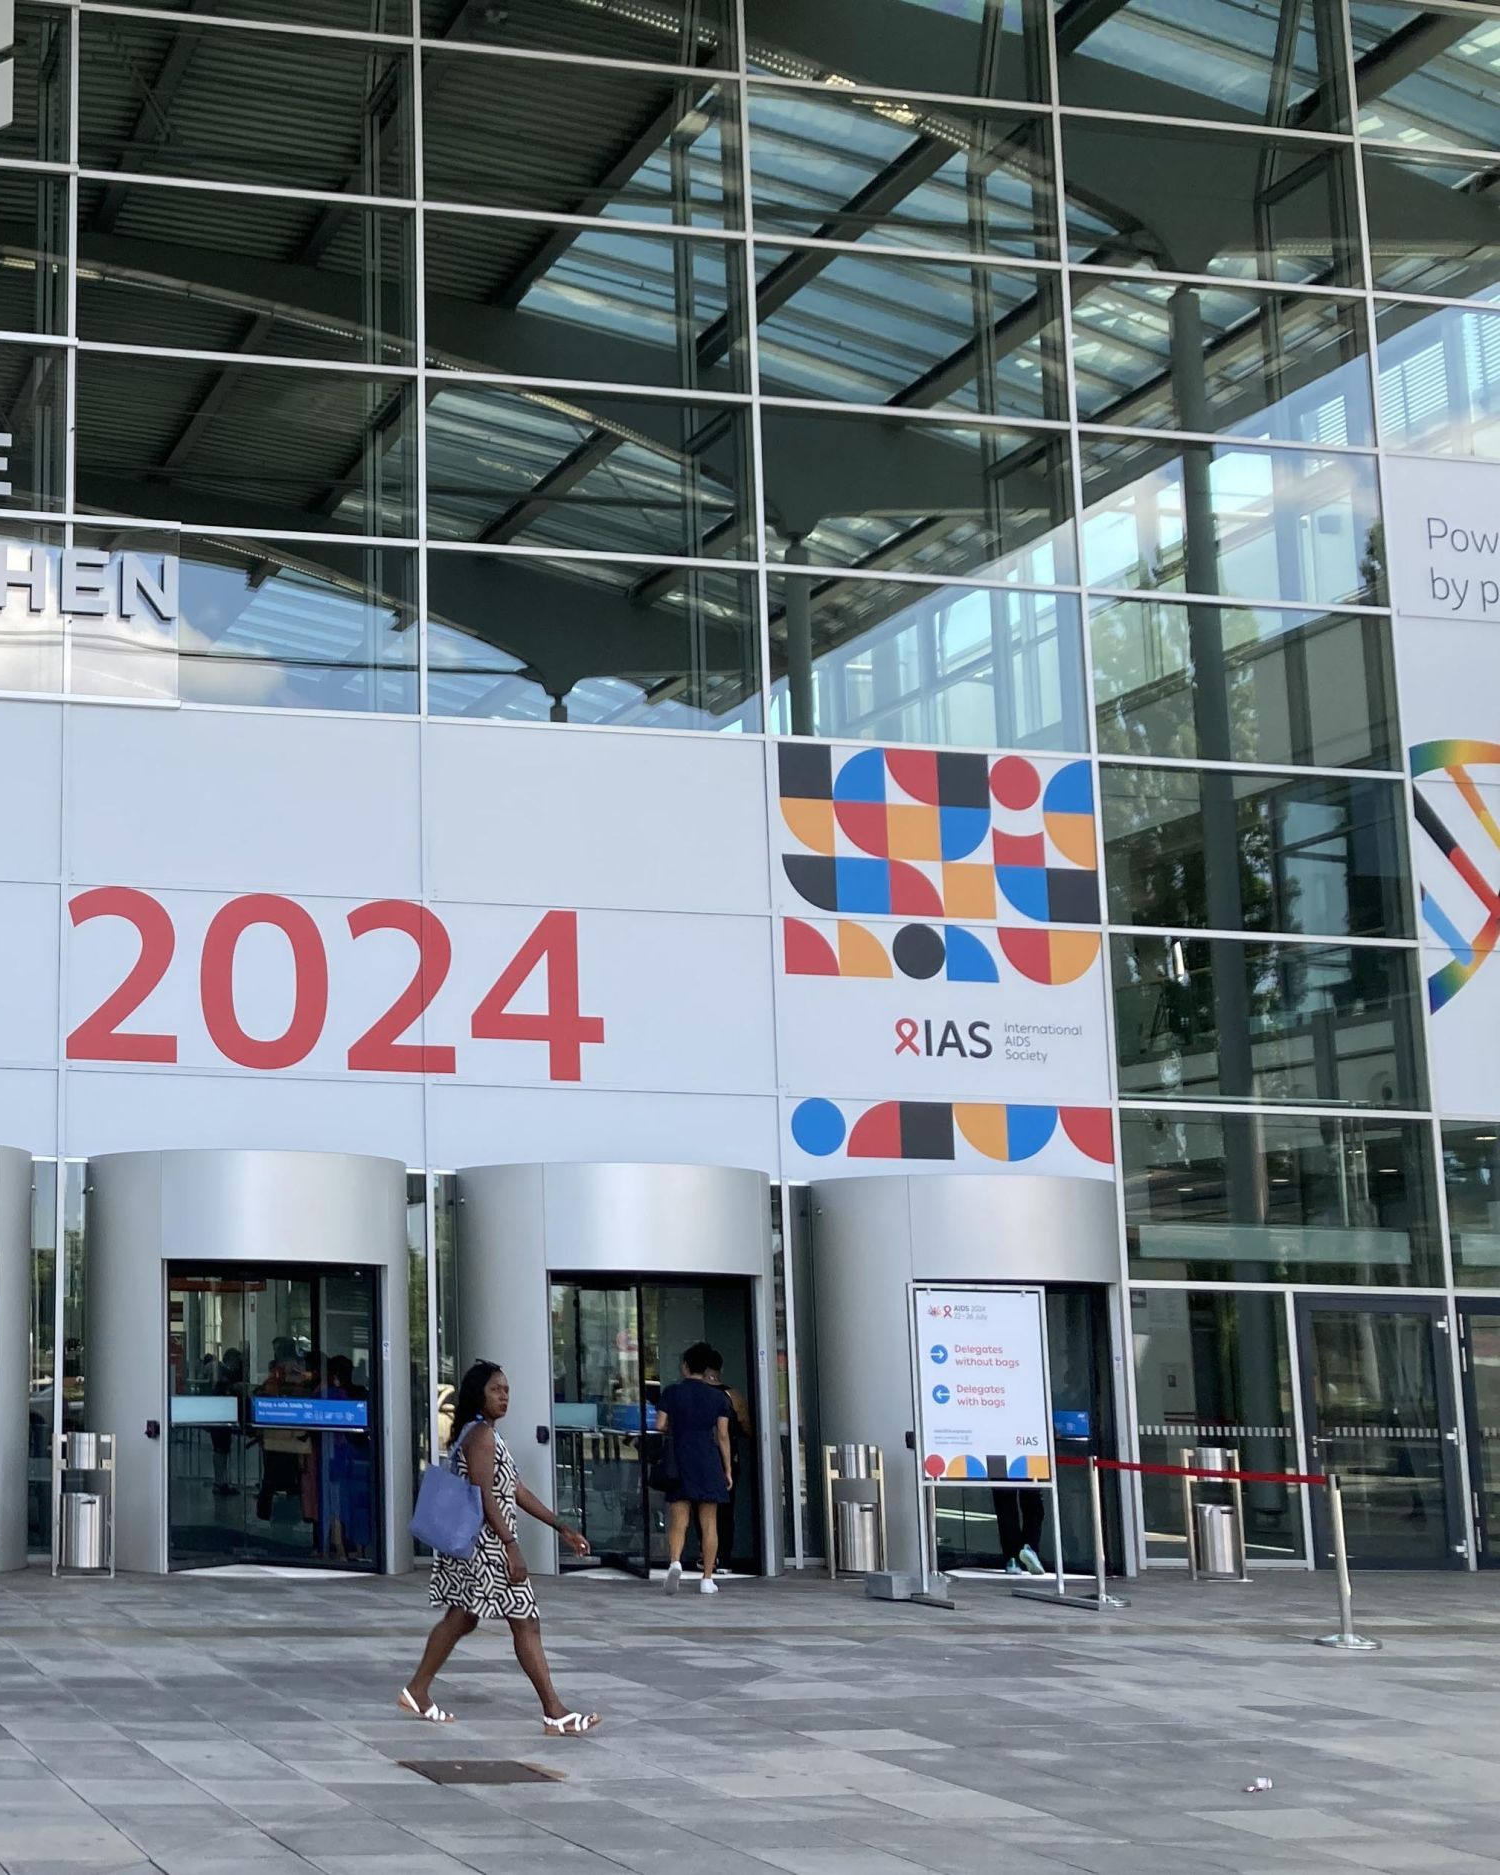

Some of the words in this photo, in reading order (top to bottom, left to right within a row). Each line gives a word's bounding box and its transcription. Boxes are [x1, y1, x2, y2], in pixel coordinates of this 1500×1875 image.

[1430, 566, 1468, 611] by
[65, 885, 605, 1082] 2024
[924, 1019, 993, 1059] IAS
[1004, 1022, 1082, 1036] International
[1005, 1035, 1031, 1047] AIDS
[1006, 1048, 1048, 1063] Society
[954, 1344, 1003, 1355] Delegates
[955, 1357, 993, 1366] without
[995, 1358, 1020, 1369] bags
[956, 1384, 1005, 1395] Delegates
[957, 1397, 979, 1406] with
[981, 1397, 1006, 1408] bags
[1022, 1436, 1039, 1446] IAS
